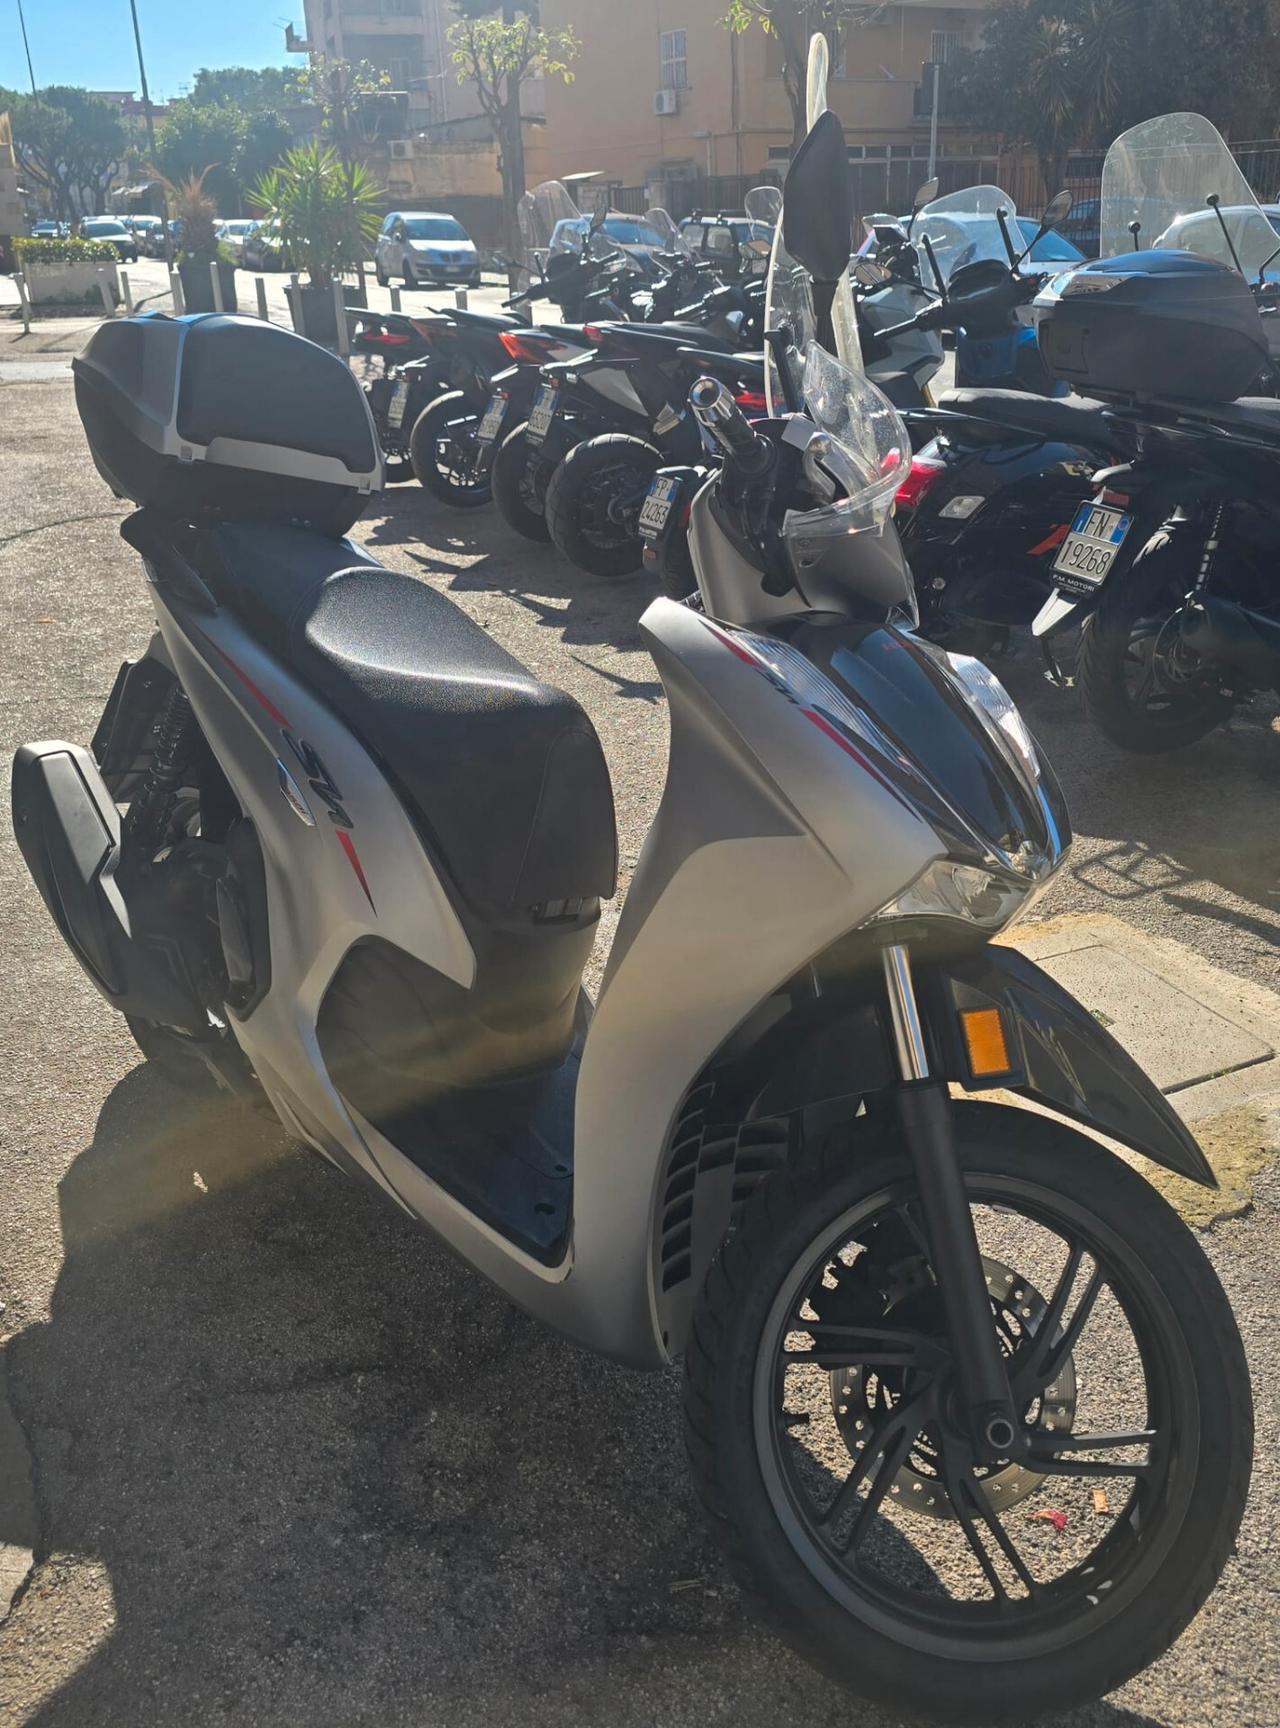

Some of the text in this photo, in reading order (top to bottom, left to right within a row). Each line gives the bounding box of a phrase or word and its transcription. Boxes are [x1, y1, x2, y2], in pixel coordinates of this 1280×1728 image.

[1083, 510, 1112, 537] FN
[1060, 540, 1112, 575] 19268
[1067, 579, 1096, 592] MOTORI
